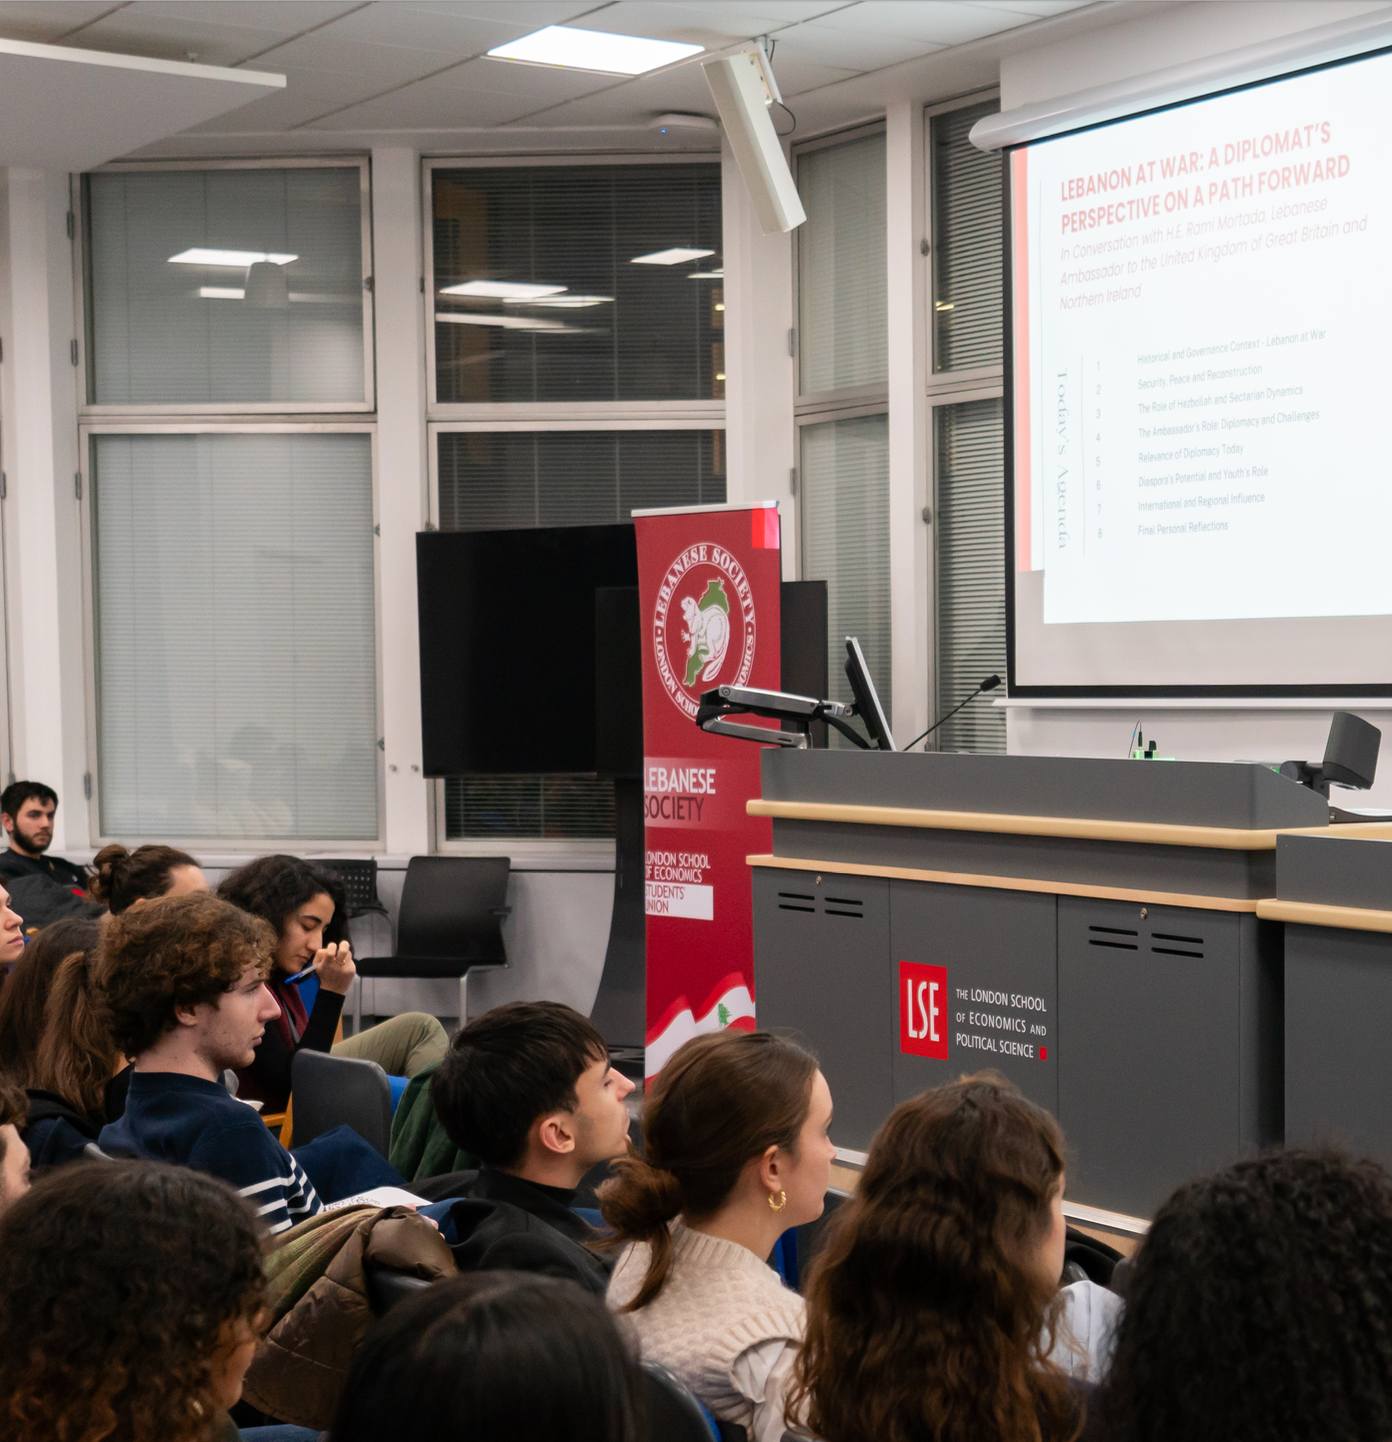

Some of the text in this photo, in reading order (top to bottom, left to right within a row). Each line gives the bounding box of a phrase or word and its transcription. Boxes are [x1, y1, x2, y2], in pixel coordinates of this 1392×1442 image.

[1060, 121, 1331, 202] LEBANON AT WAR: A DIPLOMAT'S
[1061, 154, 1351, 235] PERSPECTIVE ON A PATH FORWARD
[1060, 247, 1070, 261] In
[1073, 233, 1139, 260] Conversation
[1142, 225, 1163, 247] with
[1186, 218, 1215, 237] Rami
[1271, 198, 1328, 221] Lebanese
[1060, 213, 1368, 287] Ambassador to the United Kingdom of Great Britain and
[1059, 282, 1142, 312] Northern Ireland
[1172, 349, 1185, 361] and
[1265, 334, 1299, 348] Lebanon
[1310, 328, 1327, 341] War
[1192, 371, 1205, 384] and
[1207, 365, 1263, 381] Reconstruction
[1137, 402, 1150, 414] The
[1137, 427, 1151, 439] The
[1261, 412, 1275, 424] and
[1137, 450, 1173, 464] Relevance
[1174, 448, 1182, 460] of
[1183, 446, 1220, 460] Diplomacy
[1221, 443, 1243, 457] Today
[1175, 470, 1207, 484] Potential
[1208, 469, 1222, 482] and
[1251, 465, 1269, 477] Role
[1137, 498, 1182, 512] International
[1183, 496, 1197, 508] and
[1198, 493, 1229, 508] Regional
[1230, 491, 1266, 505] Influence
[1137, 524, 1155, 536] Final
[1157, 521, 1187, 534] Personal
[1189, 518, 1229, 533] Reflections
[655, 545, 756, 628] LEBANESE SOCIETY
[655, 637, 700, 717] LONDON SCHO
[678, 853, 711, 870] SCHOOL
[654, 867, 703, 883] ECONOMICS
[907, 979, 940, 1042] LSE
[956, 988, 1048, 1012] THE LONDON SCHOOL
[956, 1011, 1047, 1037] OF ECONOMICS AND
[956, 1033, 1034, 1059] POLITICAL SCIENCE
